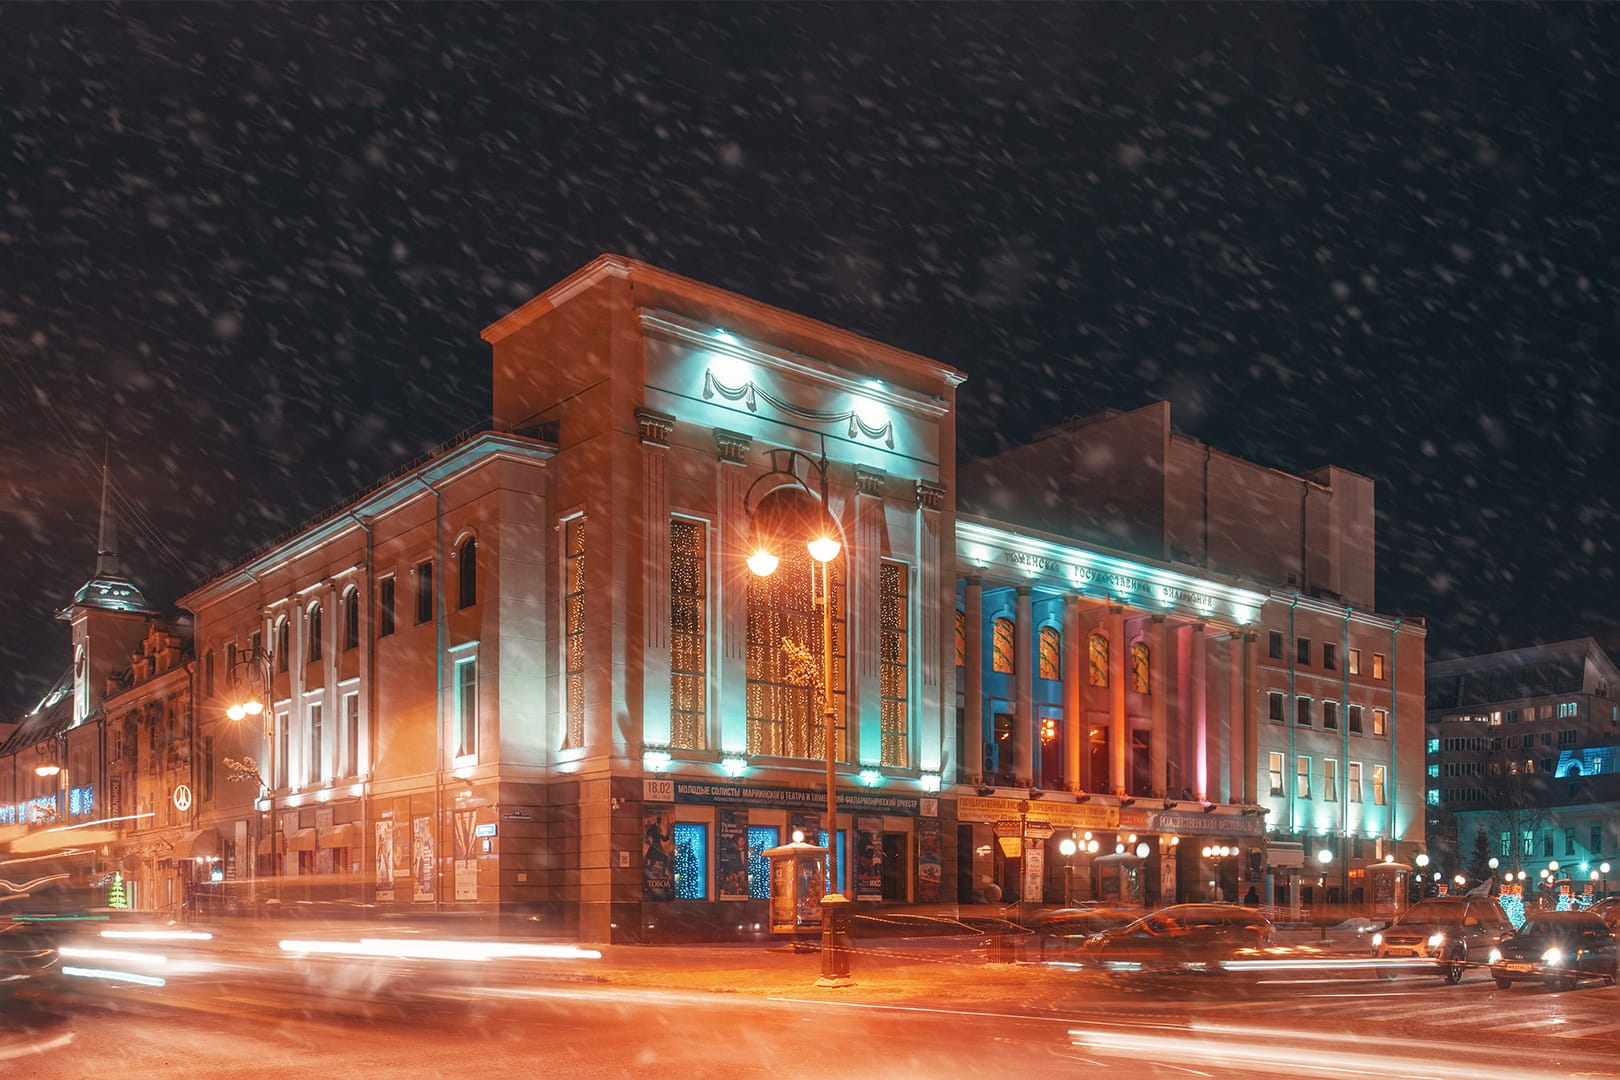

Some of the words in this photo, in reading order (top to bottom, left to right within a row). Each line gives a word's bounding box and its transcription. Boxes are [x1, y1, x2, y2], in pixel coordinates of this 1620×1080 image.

[1005, 551, 1061, 573] ТЮМЕНСКАЯ
[1162, 586, 1213, 608] ФИЛАРМОНИЯ
[648, 782, 671, 794] 18.02
[677, 784, 711, 796] МОЛОДЫЕ
[711, 786, 741, 797] СОЛИСТЫ
[785, 791, 805, 801] ТЕАТРА
[1159, 815, 1217, 830] РОЖДЕСТВЕНСКИЙ
